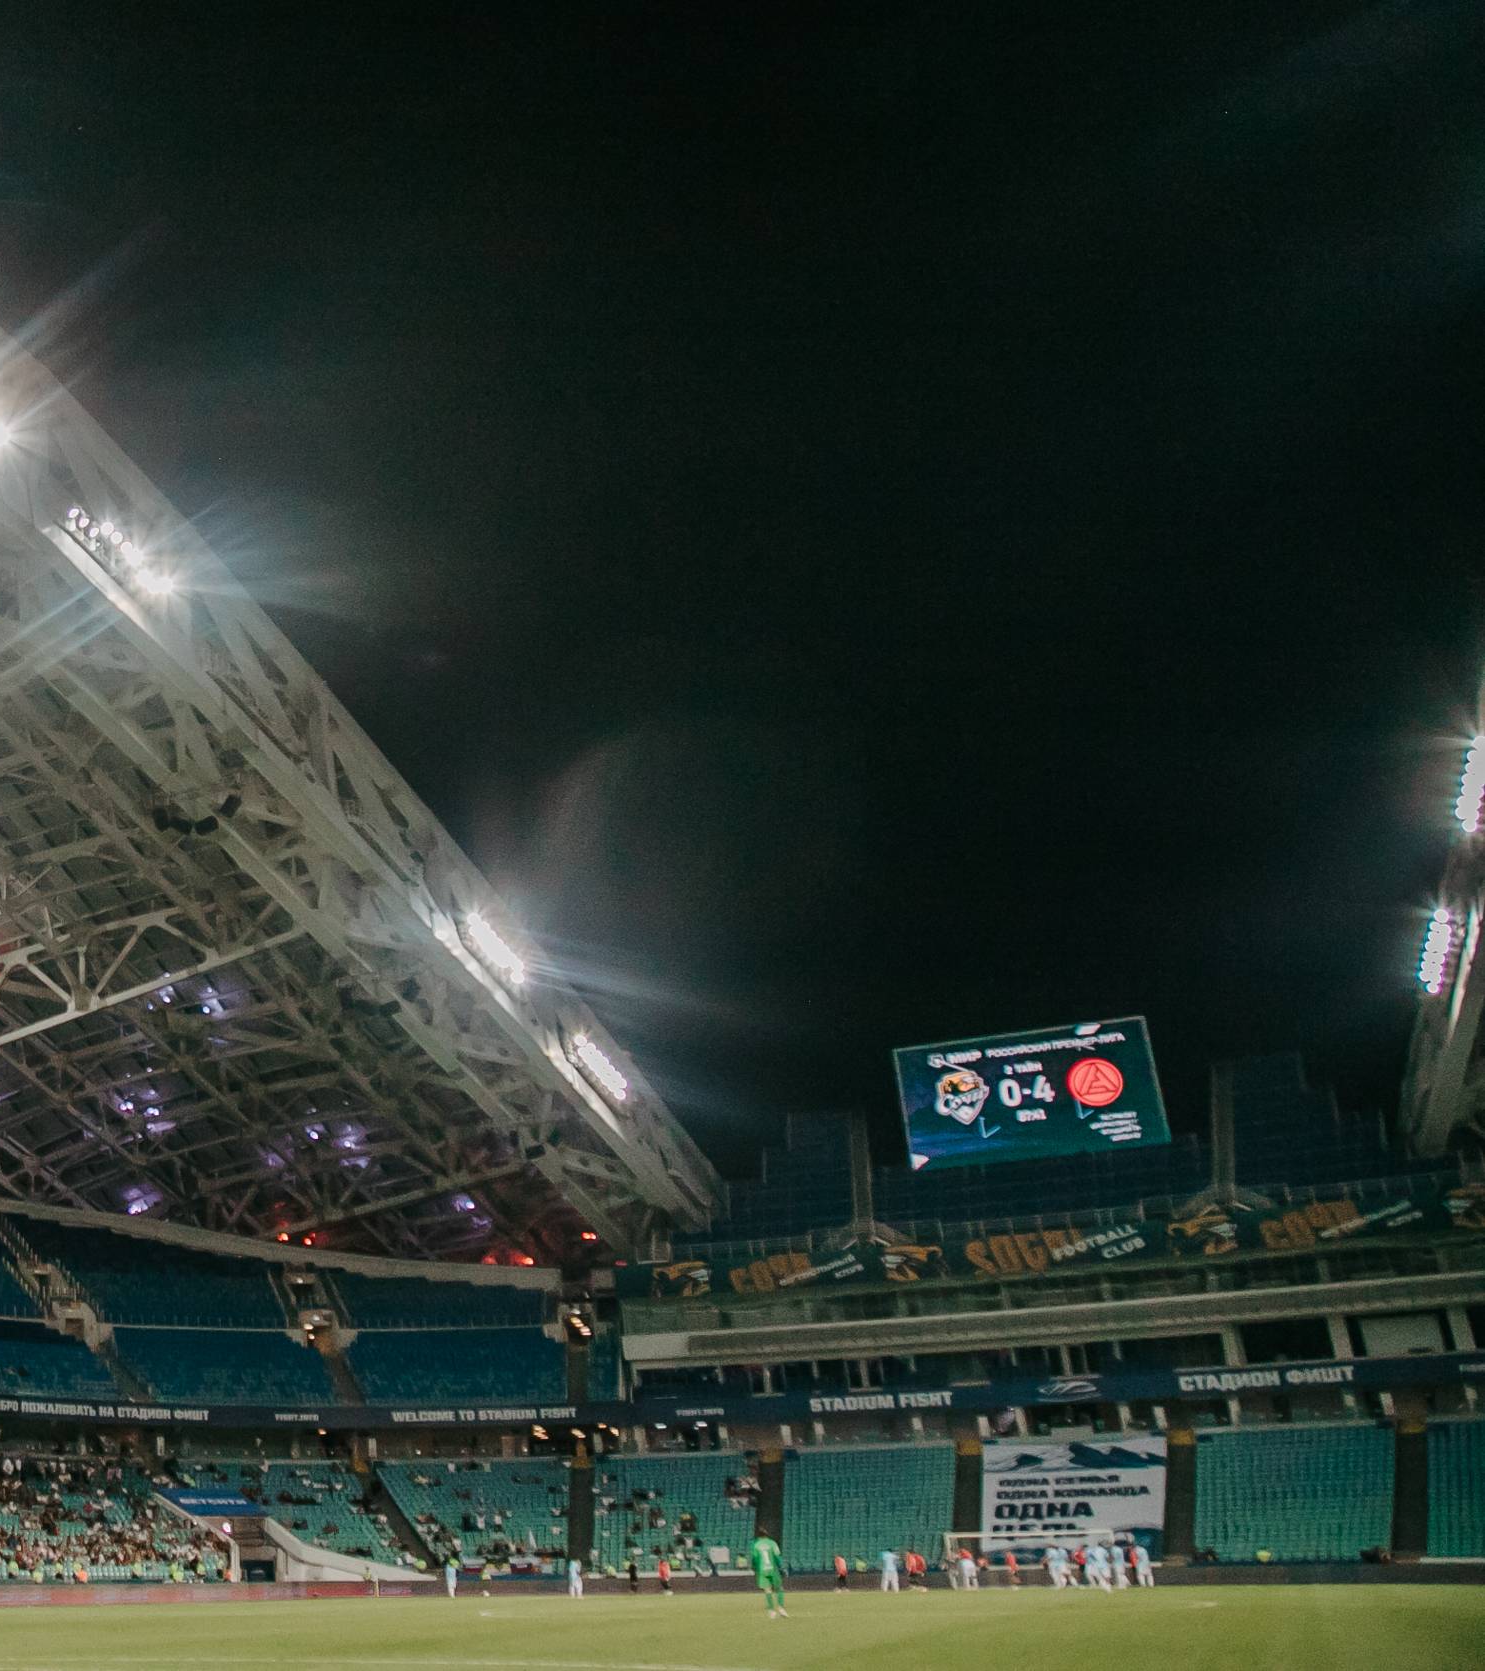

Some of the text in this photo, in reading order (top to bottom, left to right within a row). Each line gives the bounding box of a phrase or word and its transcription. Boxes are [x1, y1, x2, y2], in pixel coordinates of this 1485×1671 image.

[1051, 1224, 1138, 1262] FOOTBALL
[1101, 1237, 1146, 1259] CLUB
[1178, 1365, 1354, 1392] СТАДИОН ФИШТ
[21, 1401, 96, 1417] ПОЖАЛОВАТЬ
[99, 1406, 115, 1418] НА
[117, 1406, 171, 1420] СТАДИОН
[174, 1408, 209, 1421] ФИШТ
[809, 1391, 953, 1413] STADIUM FISHT
[391, 1407, 577, 1422] WELCOME TO STADIUM FISHT
[994, 1501, 1095, 1521] ОДНА
